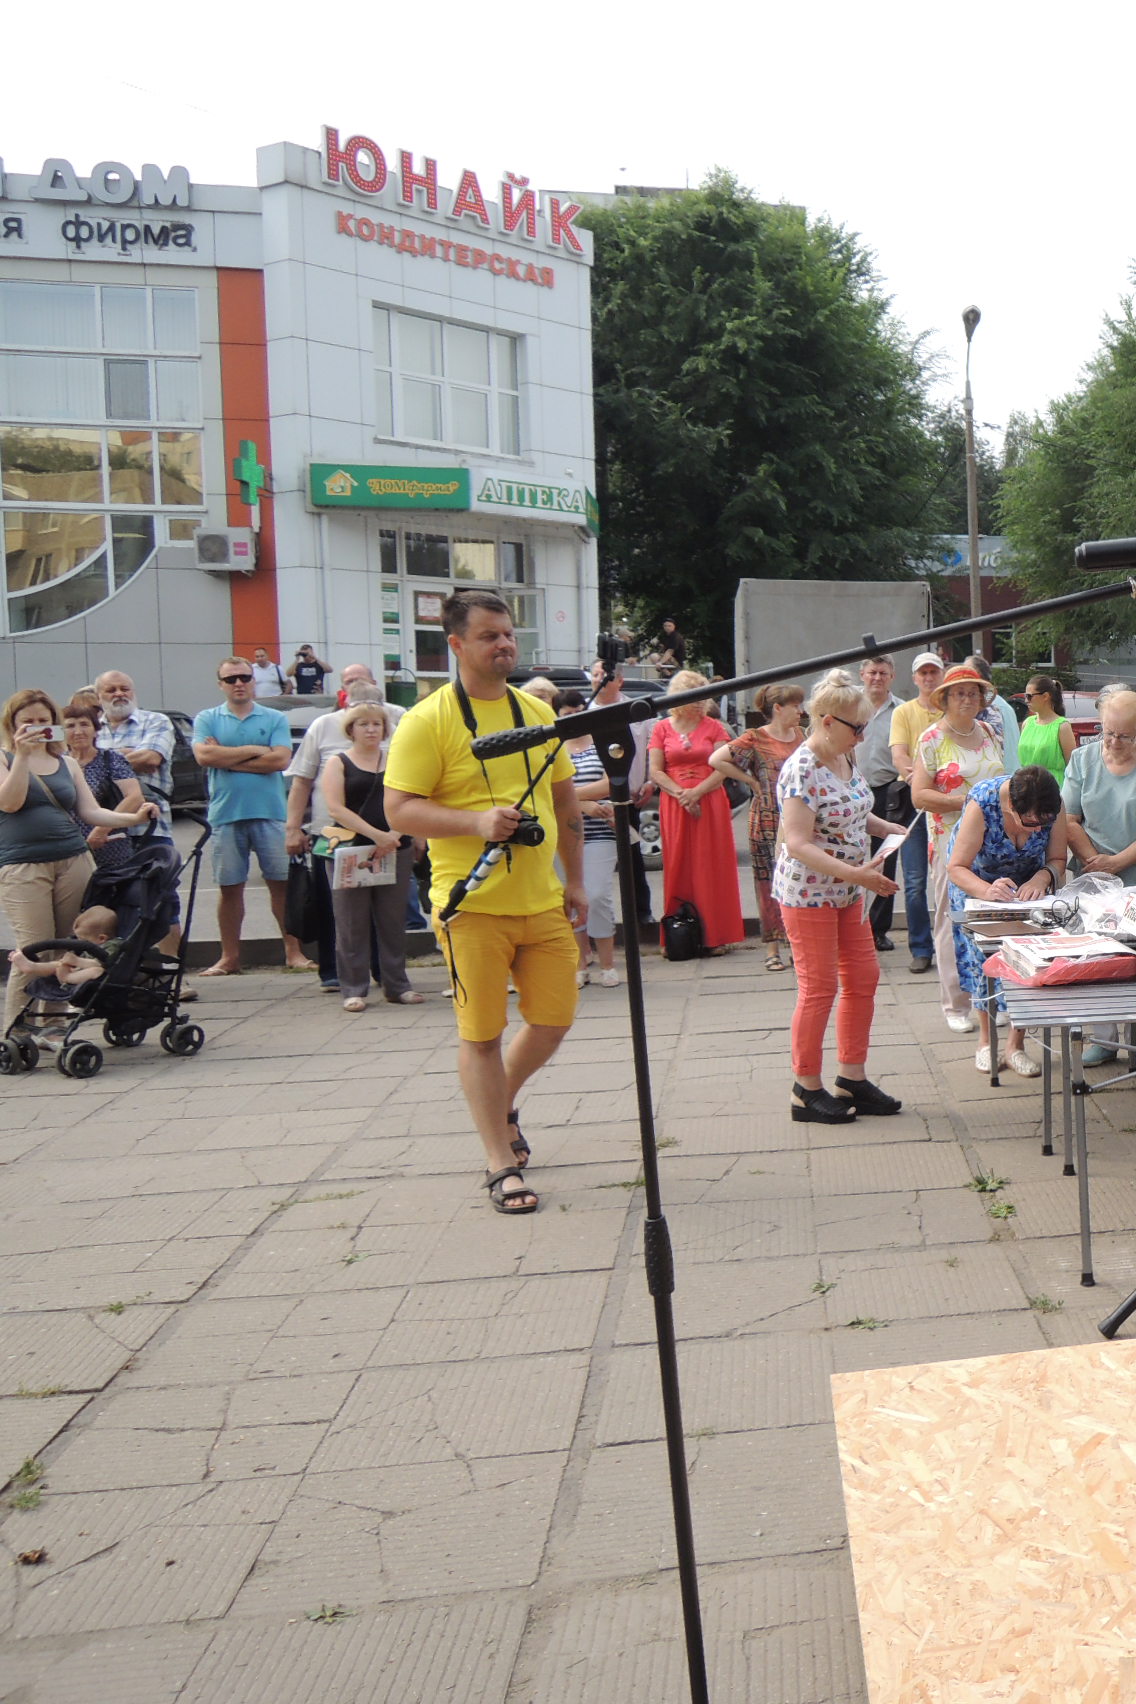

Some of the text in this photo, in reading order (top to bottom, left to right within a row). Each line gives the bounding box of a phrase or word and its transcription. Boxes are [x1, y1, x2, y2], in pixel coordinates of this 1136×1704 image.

[30, 158, 191, 207] ДОМ
[321, 124, 587, 257] ЮНАЙК
[61, 213, 196, 252] фирма
[336, 210, 556, 290] КОНДИТЕРСКАЯ
[477, 478, 587, 514] АПТЕКА
